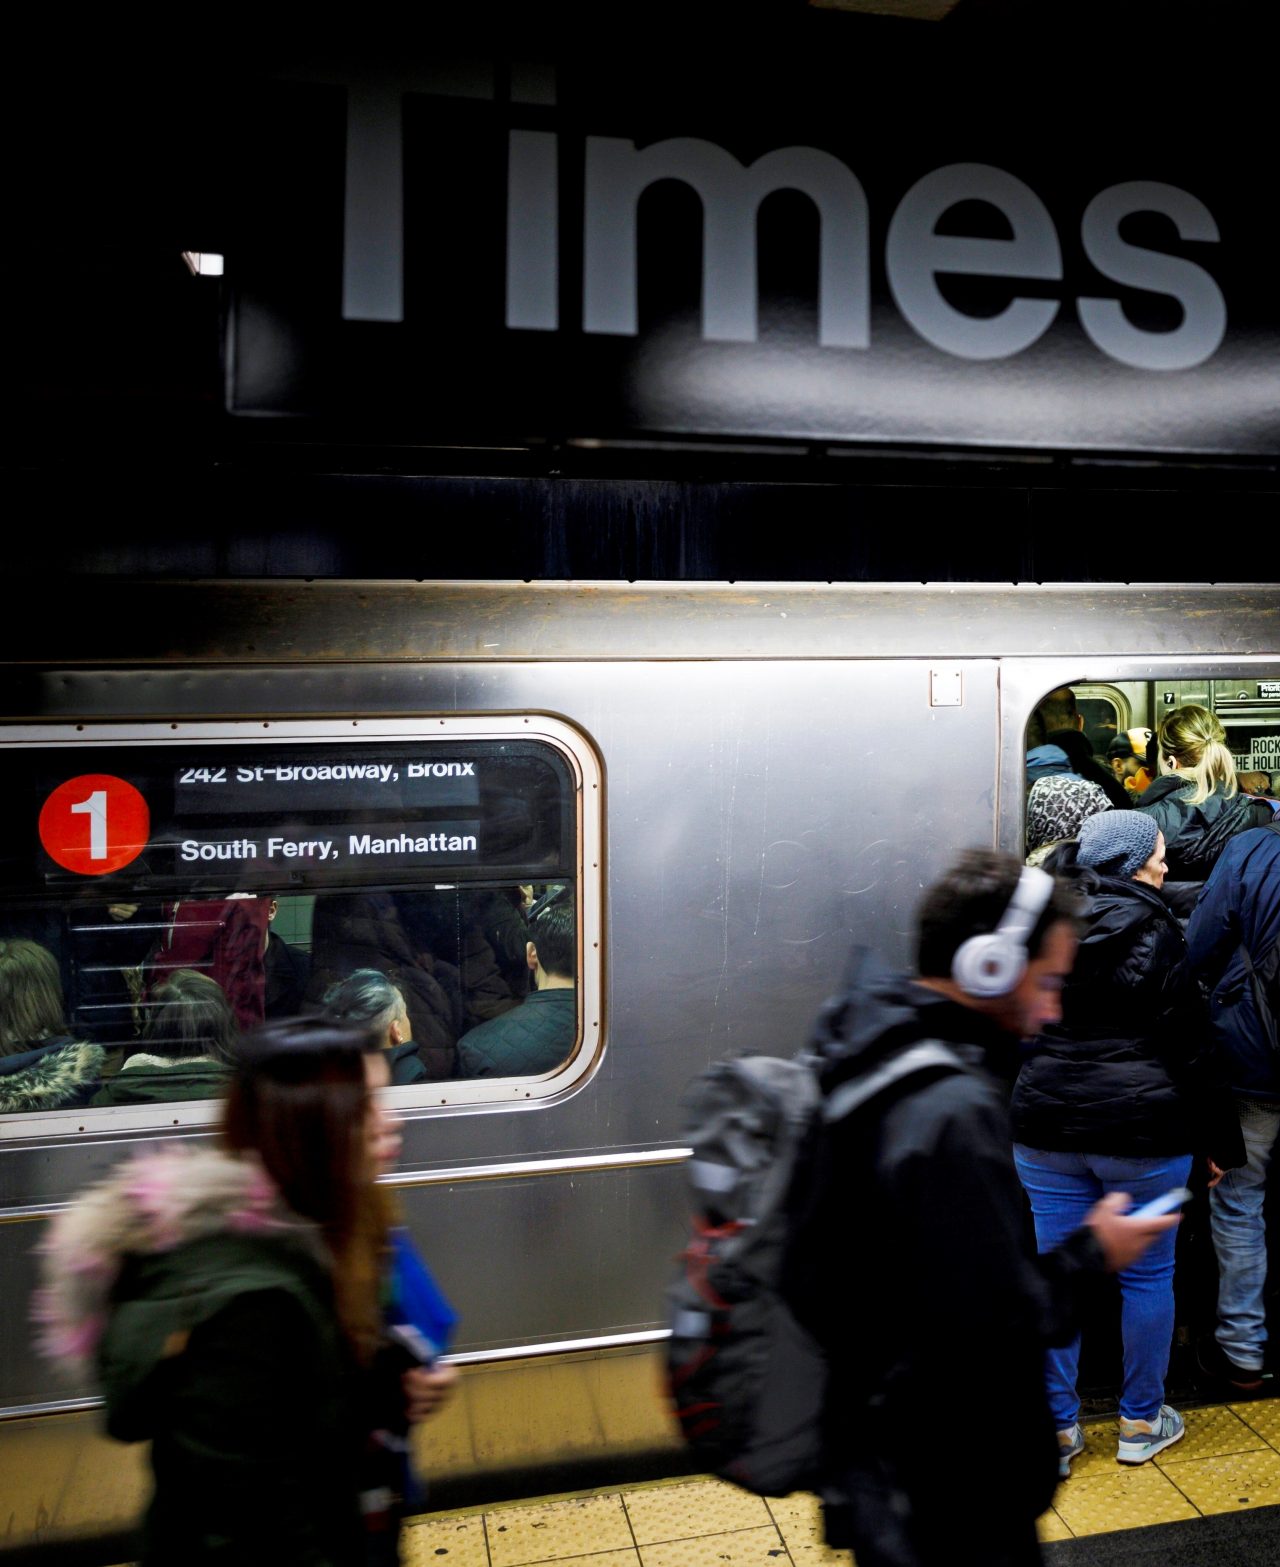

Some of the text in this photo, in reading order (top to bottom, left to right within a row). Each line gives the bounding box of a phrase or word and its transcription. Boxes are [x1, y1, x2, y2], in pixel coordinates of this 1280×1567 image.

[285, 62, 1228, 371] Times
[180, 766, 227, 784] 242
[407, 761, 475, 778] Bronx
[71, 790, 108, 860] 1
[181, 832, 477, 861] South Ferry, Manhattan
